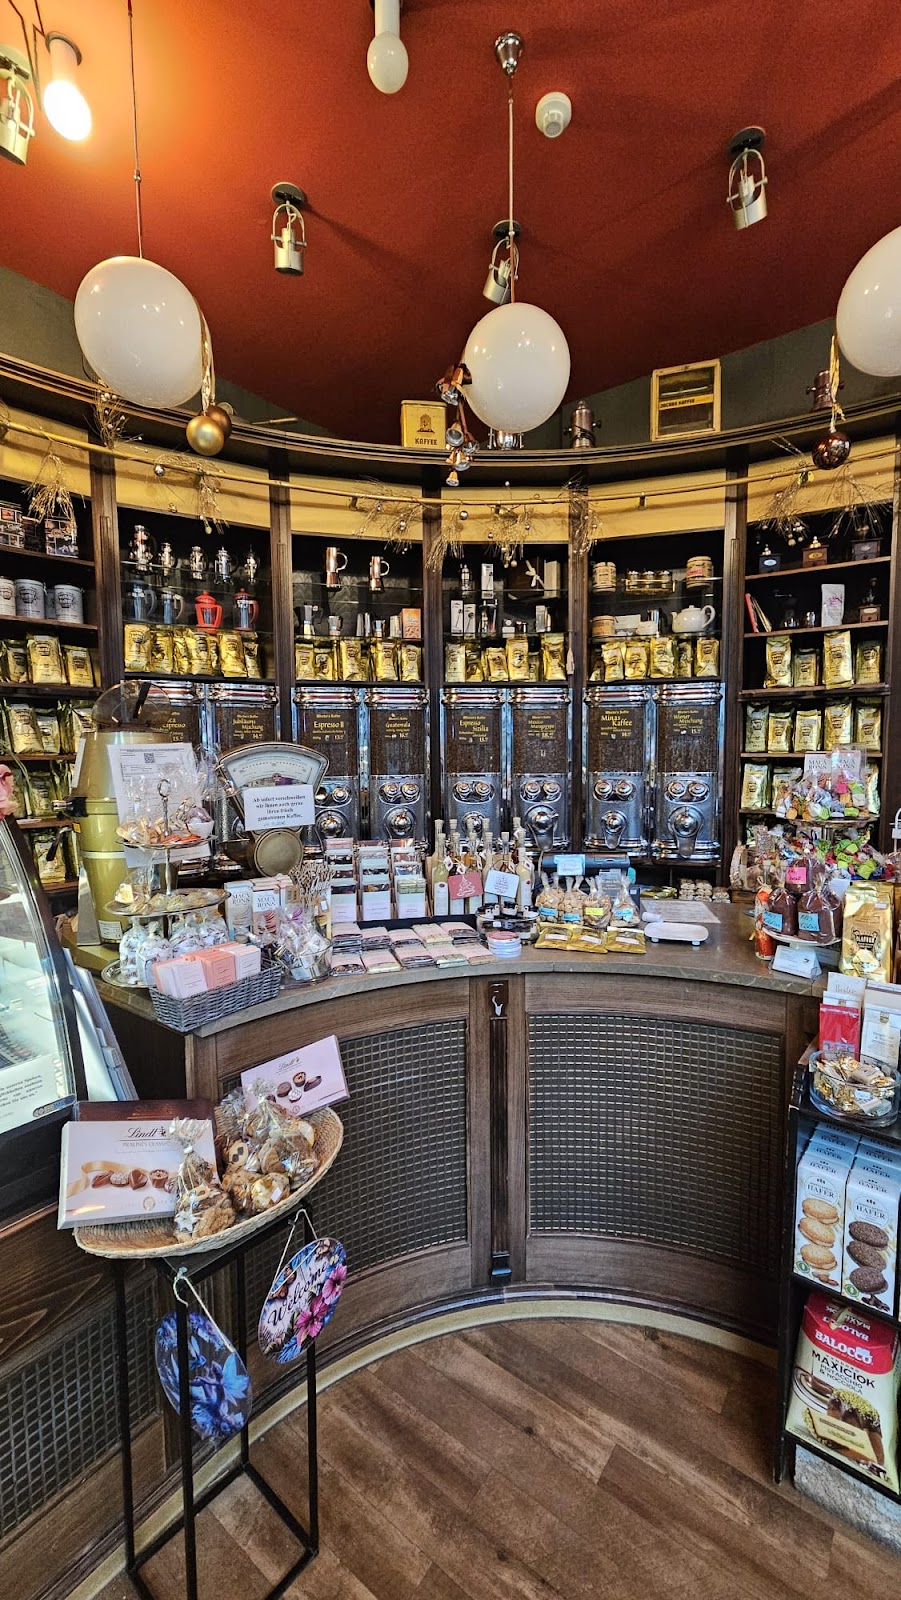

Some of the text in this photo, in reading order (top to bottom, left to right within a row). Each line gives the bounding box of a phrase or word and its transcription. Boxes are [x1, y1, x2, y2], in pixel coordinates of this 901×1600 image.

[313, 721, 339, 730] Espresso
[279, 1058, 297, 1070] Lindt
[128, 1127, 158, 1138] Lindt
[816, 1148, 841, 1160] HAFER
[866, 1151, 893, 1163] HAFER
[810, 1162, 837, 1174] HAFER
[863, 1166, 890, 1178] HAFER
[807, 1184, 835, 1198] HAFER
[859, 1181, 887, 1193] HAFER
[856, 1204, 885, 1219] HAFER
[268, 1261, 327, 1326] Welcome
[814, 1329, 873, 1365] BALOCCO
[811, 1350, 875, 1388] MAXICIOK
[820, 1363, 863, 1389] PISTACCHIO
[826, 1372, 863, 1395] NOCCIOLA
